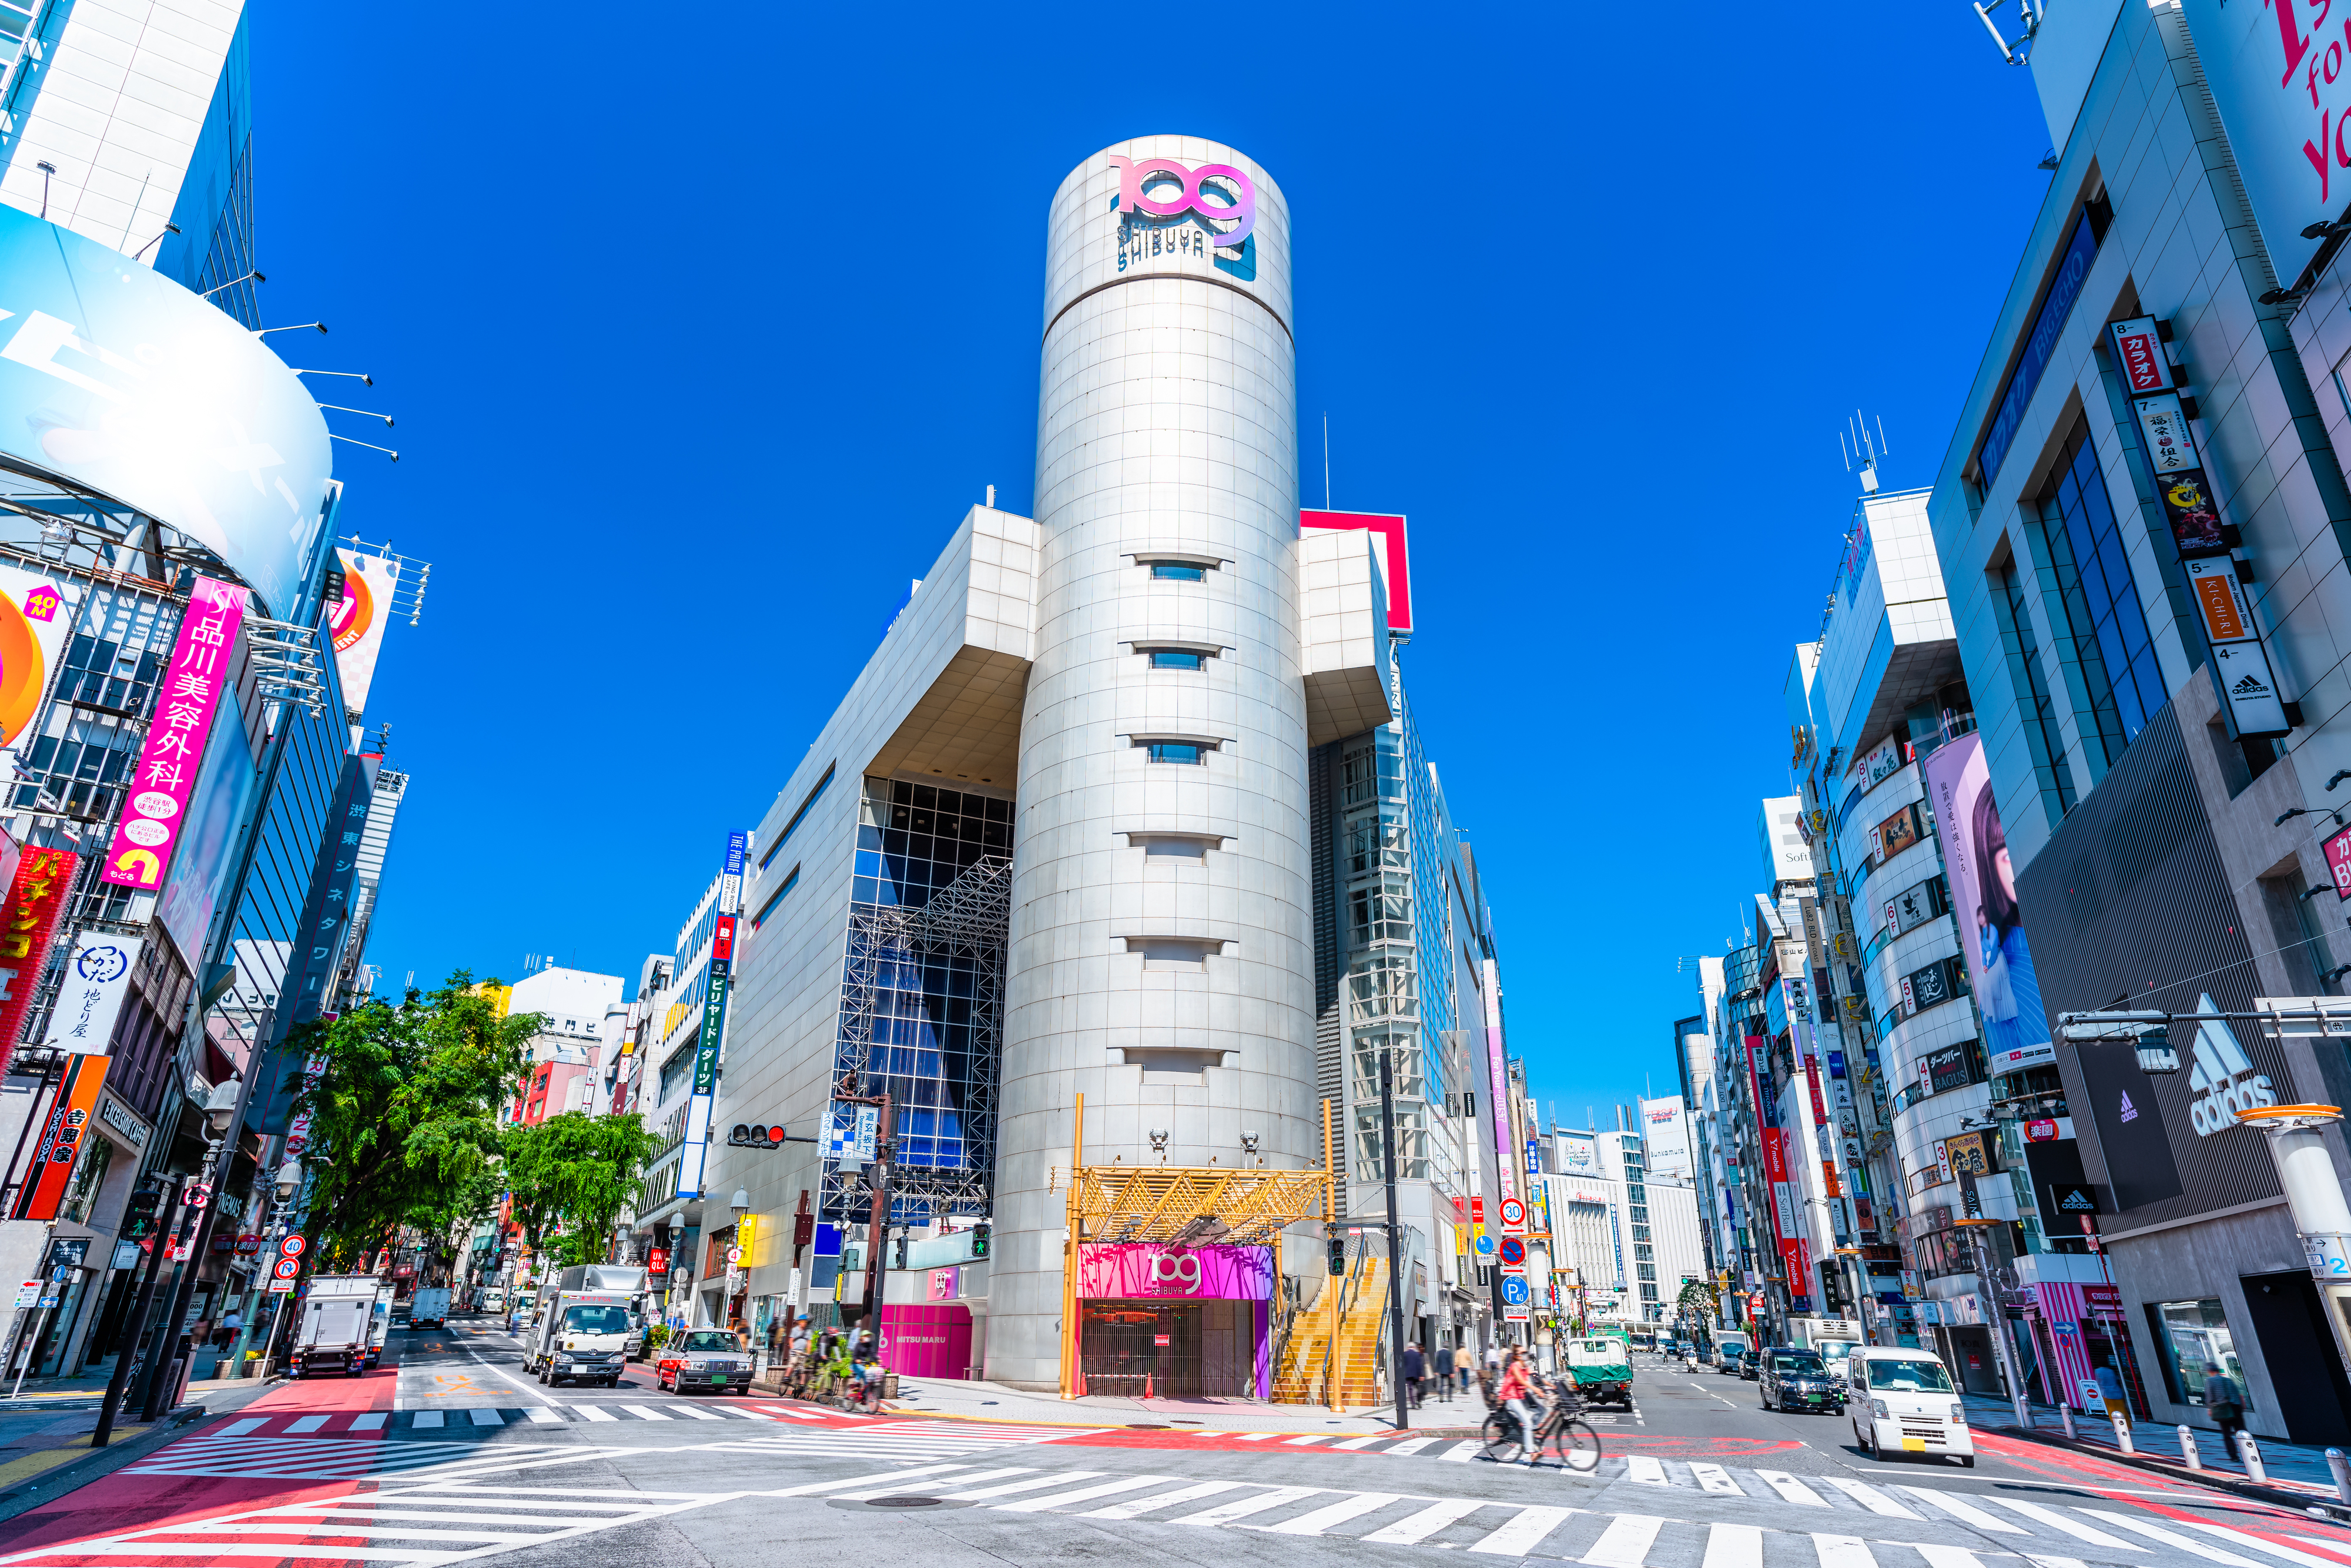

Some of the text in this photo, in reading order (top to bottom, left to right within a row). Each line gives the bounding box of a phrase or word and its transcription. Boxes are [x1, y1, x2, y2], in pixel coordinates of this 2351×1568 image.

[1109, 155, 1256, 247] 109
[1117, 222, 1203, 244] SHIBUYA
[2035, 252, 2084, 365] BIG ECHO
[2149, 333, 2158, 350] カラオケ
[2128, 339, 2155, 386] カラオケ
[1986, 366, 2028, 475] カラオケ
[2227, 574, 2249, 628] Modern Japanese Dining
[2232, 685, 2269, 694] adidas
[145, 617, 226, 792] 品川美容外科
[138, 803, 171, 815] 徒歩1分
[143, 796, 171, 808] 渋谷駅
[131, 830, 160, 839] にあるビル
[727, 835, 744, 873] THE PRIME
[1786, 851, 1811, 862] Soft
[110, 870, 134, 880] もどる
[0, 852, 62, 958] パチンコ
[309, 805, 366, 990] 渋東シネタワー
[88, 946, 117, 983] つかだ
[1811, 949, 1820, 963] COAST
[69, 989, 101, 1038] 地どり屋
[698, 979, 724, 1084] ビリヤード・ダーツ
[1930, 1050, 1961, 1068] ダーツバー
[1492, 1056, 1506, 1123] For Your JUST
[1934, 1070, 1967, 1090] BAGUS
[103, 1100, 132, 1134] EXCELSIOR
[2121, 1108, 2138, 1123] adidas
[2191, 1076, 2275, 1137] adidas
[51, 1108, 88, 1164] 吉野家
[820, 1113, 832, 1155] スクランブル式
[863, 1112, 875, 1155] 道玄坂下
[2031, 1124, 2055, 1137] 楽園
[1651, 1148, 1684, 1158] Bunkamura
[1769, 1137, 1780, 1173] Y!mobile
[1825, 1164, 1836, 1194] 駄菓子バー
[1506, 1206, 1521, 1218] 30
[1967, 1190, 1977, 1214] SAIN
[2062, 1201, 2094, 1209] adidas
[1779, 1197, 1793, 1235] SoftBank
[1833, 1205, 1843, 1229] DIANA
[238, 1241, 259, 1251] 楽園
[286, 1241, 300, 1251] 40
[652, 1252, 667, 1261] UNI
[731, 1251, 737, 1260] 4
[651, 1261, 666, 1271] QLO
[1148, 1252, 1202, 1295] 109
[1786, 1248, 1800, 1286] Y!mobile
[2329, 1258, 2349, 1274] 2
[1151, 1287, 1184, 1295] SHIBUYA
[1508, 1284, 1518, 1302] P
[1516, 1294, 1523, 1302] 40
[1824, 1271, 1837, 1303] 一風騎士
[1925, 1304, 1935, 1319] 眼鏡
